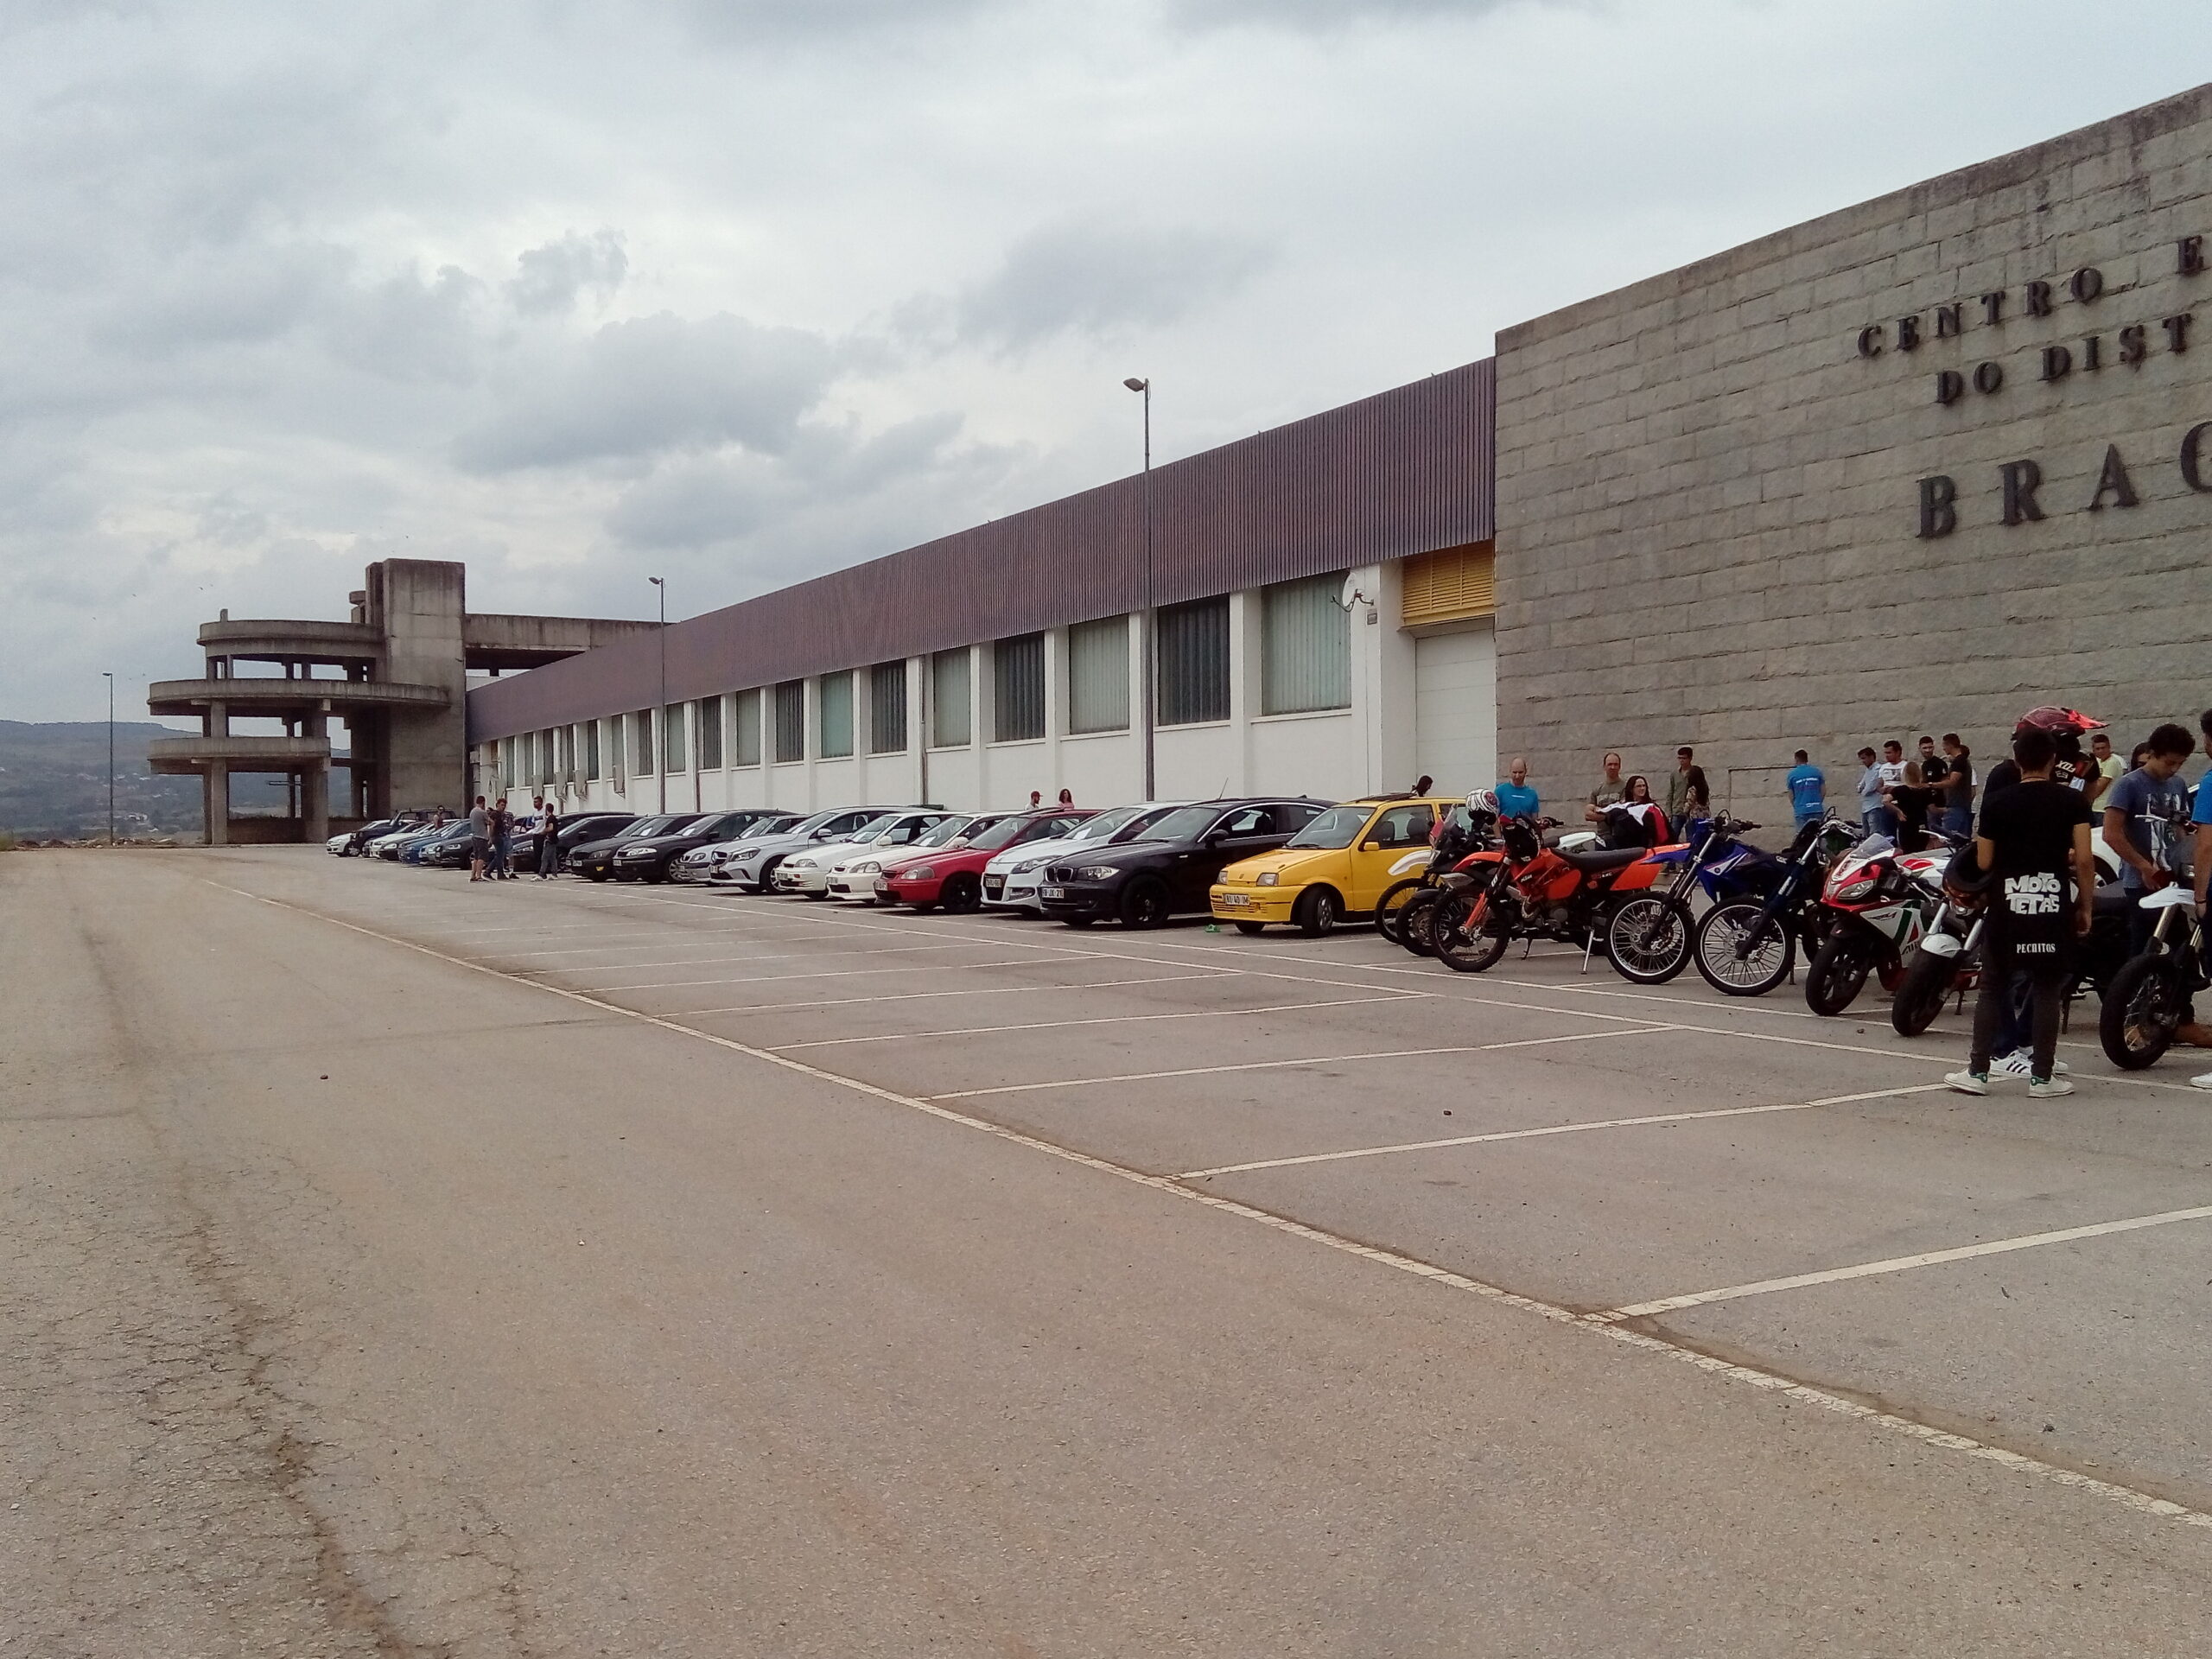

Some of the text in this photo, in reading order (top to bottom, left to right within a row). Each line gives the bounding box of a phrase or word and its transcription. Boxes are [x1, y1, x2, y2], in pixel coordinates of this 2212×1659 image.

[1857, 266, 2104, 358] CENTRO
[1936, 313, 2193, 404] DO DIST
[2005, 871, 2061, 894] MOTO
[2005, 893, 2060, 914] TETAS
[2016, 943, 2056, 953] PECHITOS
